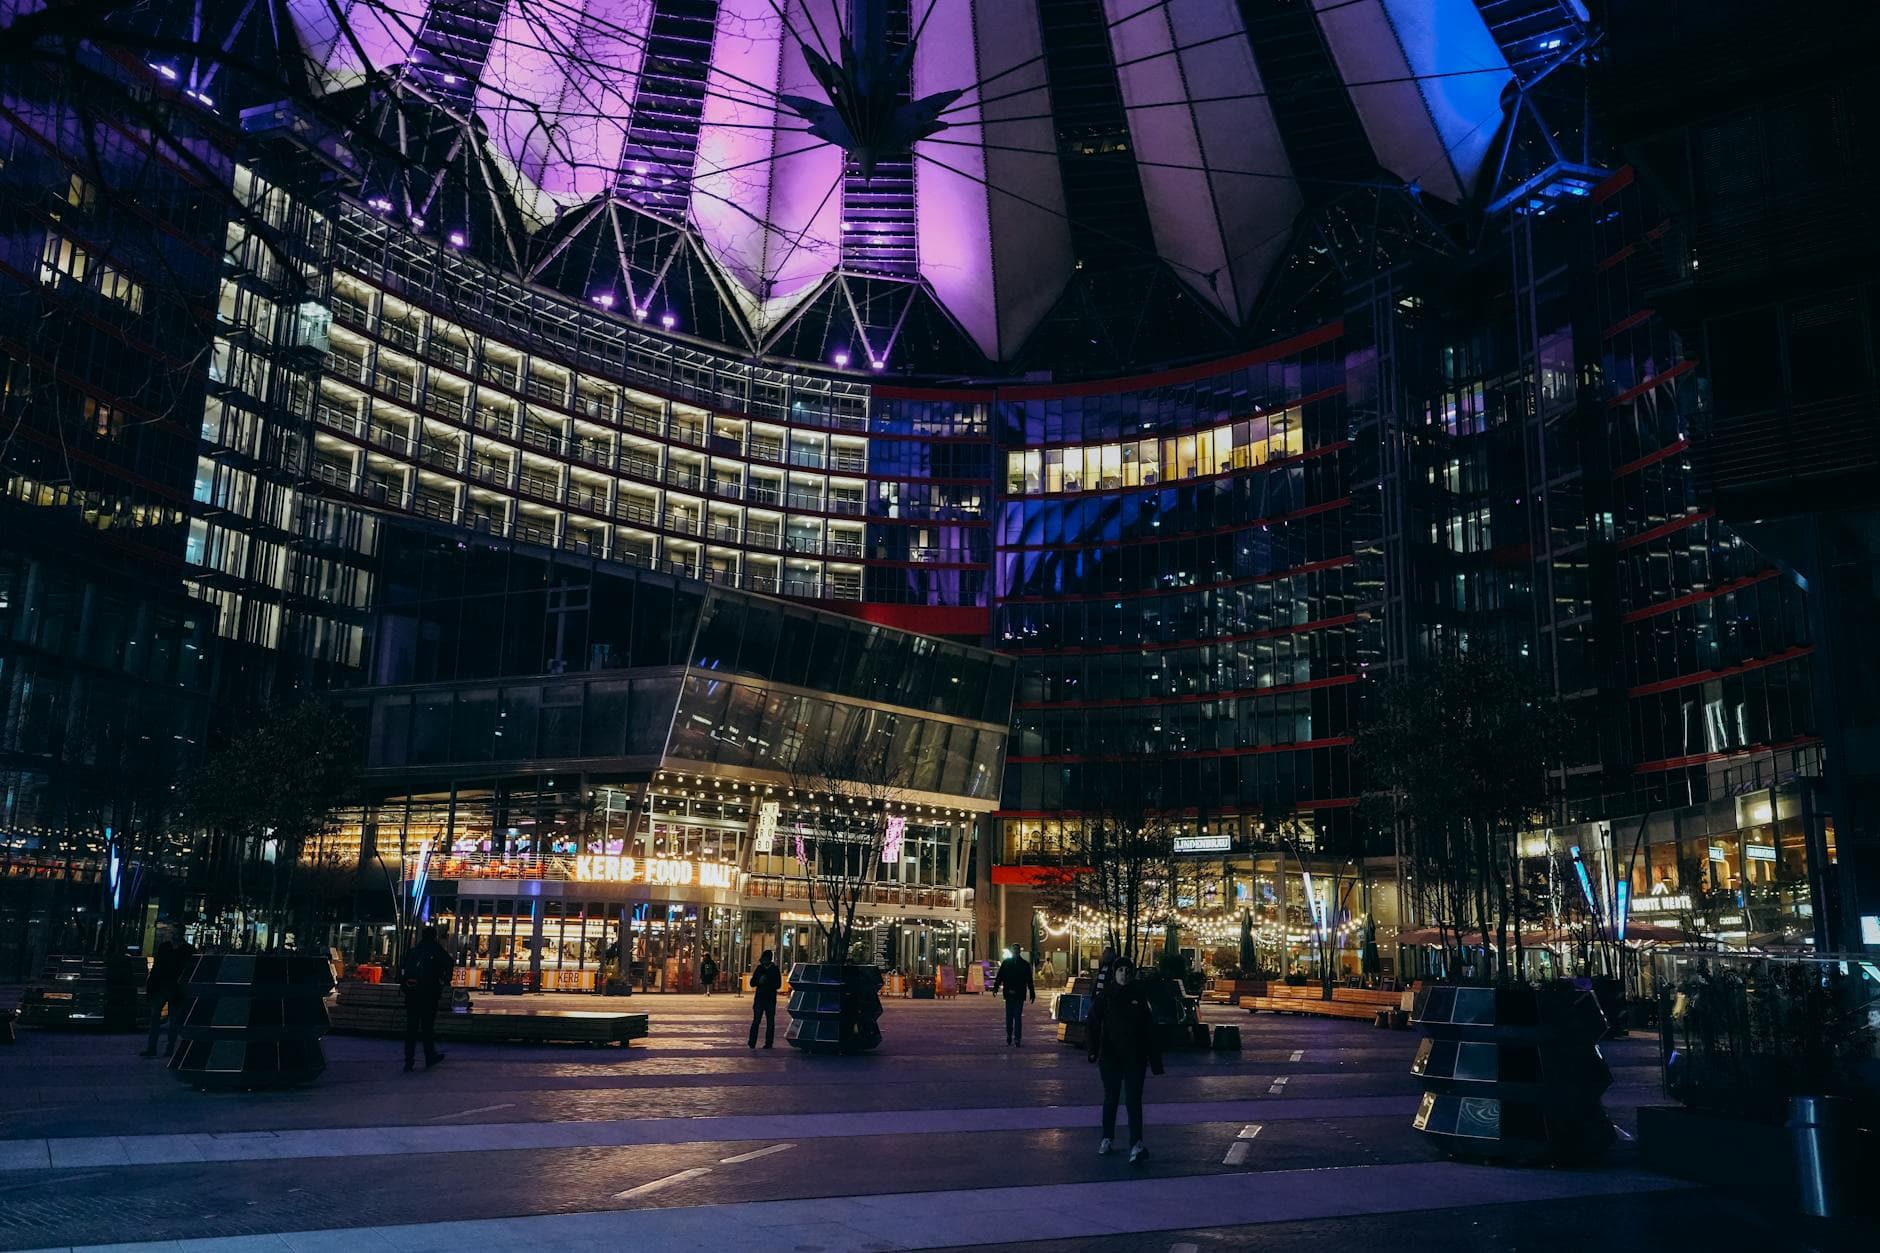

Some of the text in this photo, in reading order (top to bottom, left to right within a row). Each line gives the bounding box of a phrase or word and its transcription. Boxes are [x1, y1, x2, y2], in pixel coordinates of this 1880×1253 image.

[577, 855, 635, 881] KERB
[645, 858, 692, 886] FOOD
[558, 972, 579, 982] KERB
